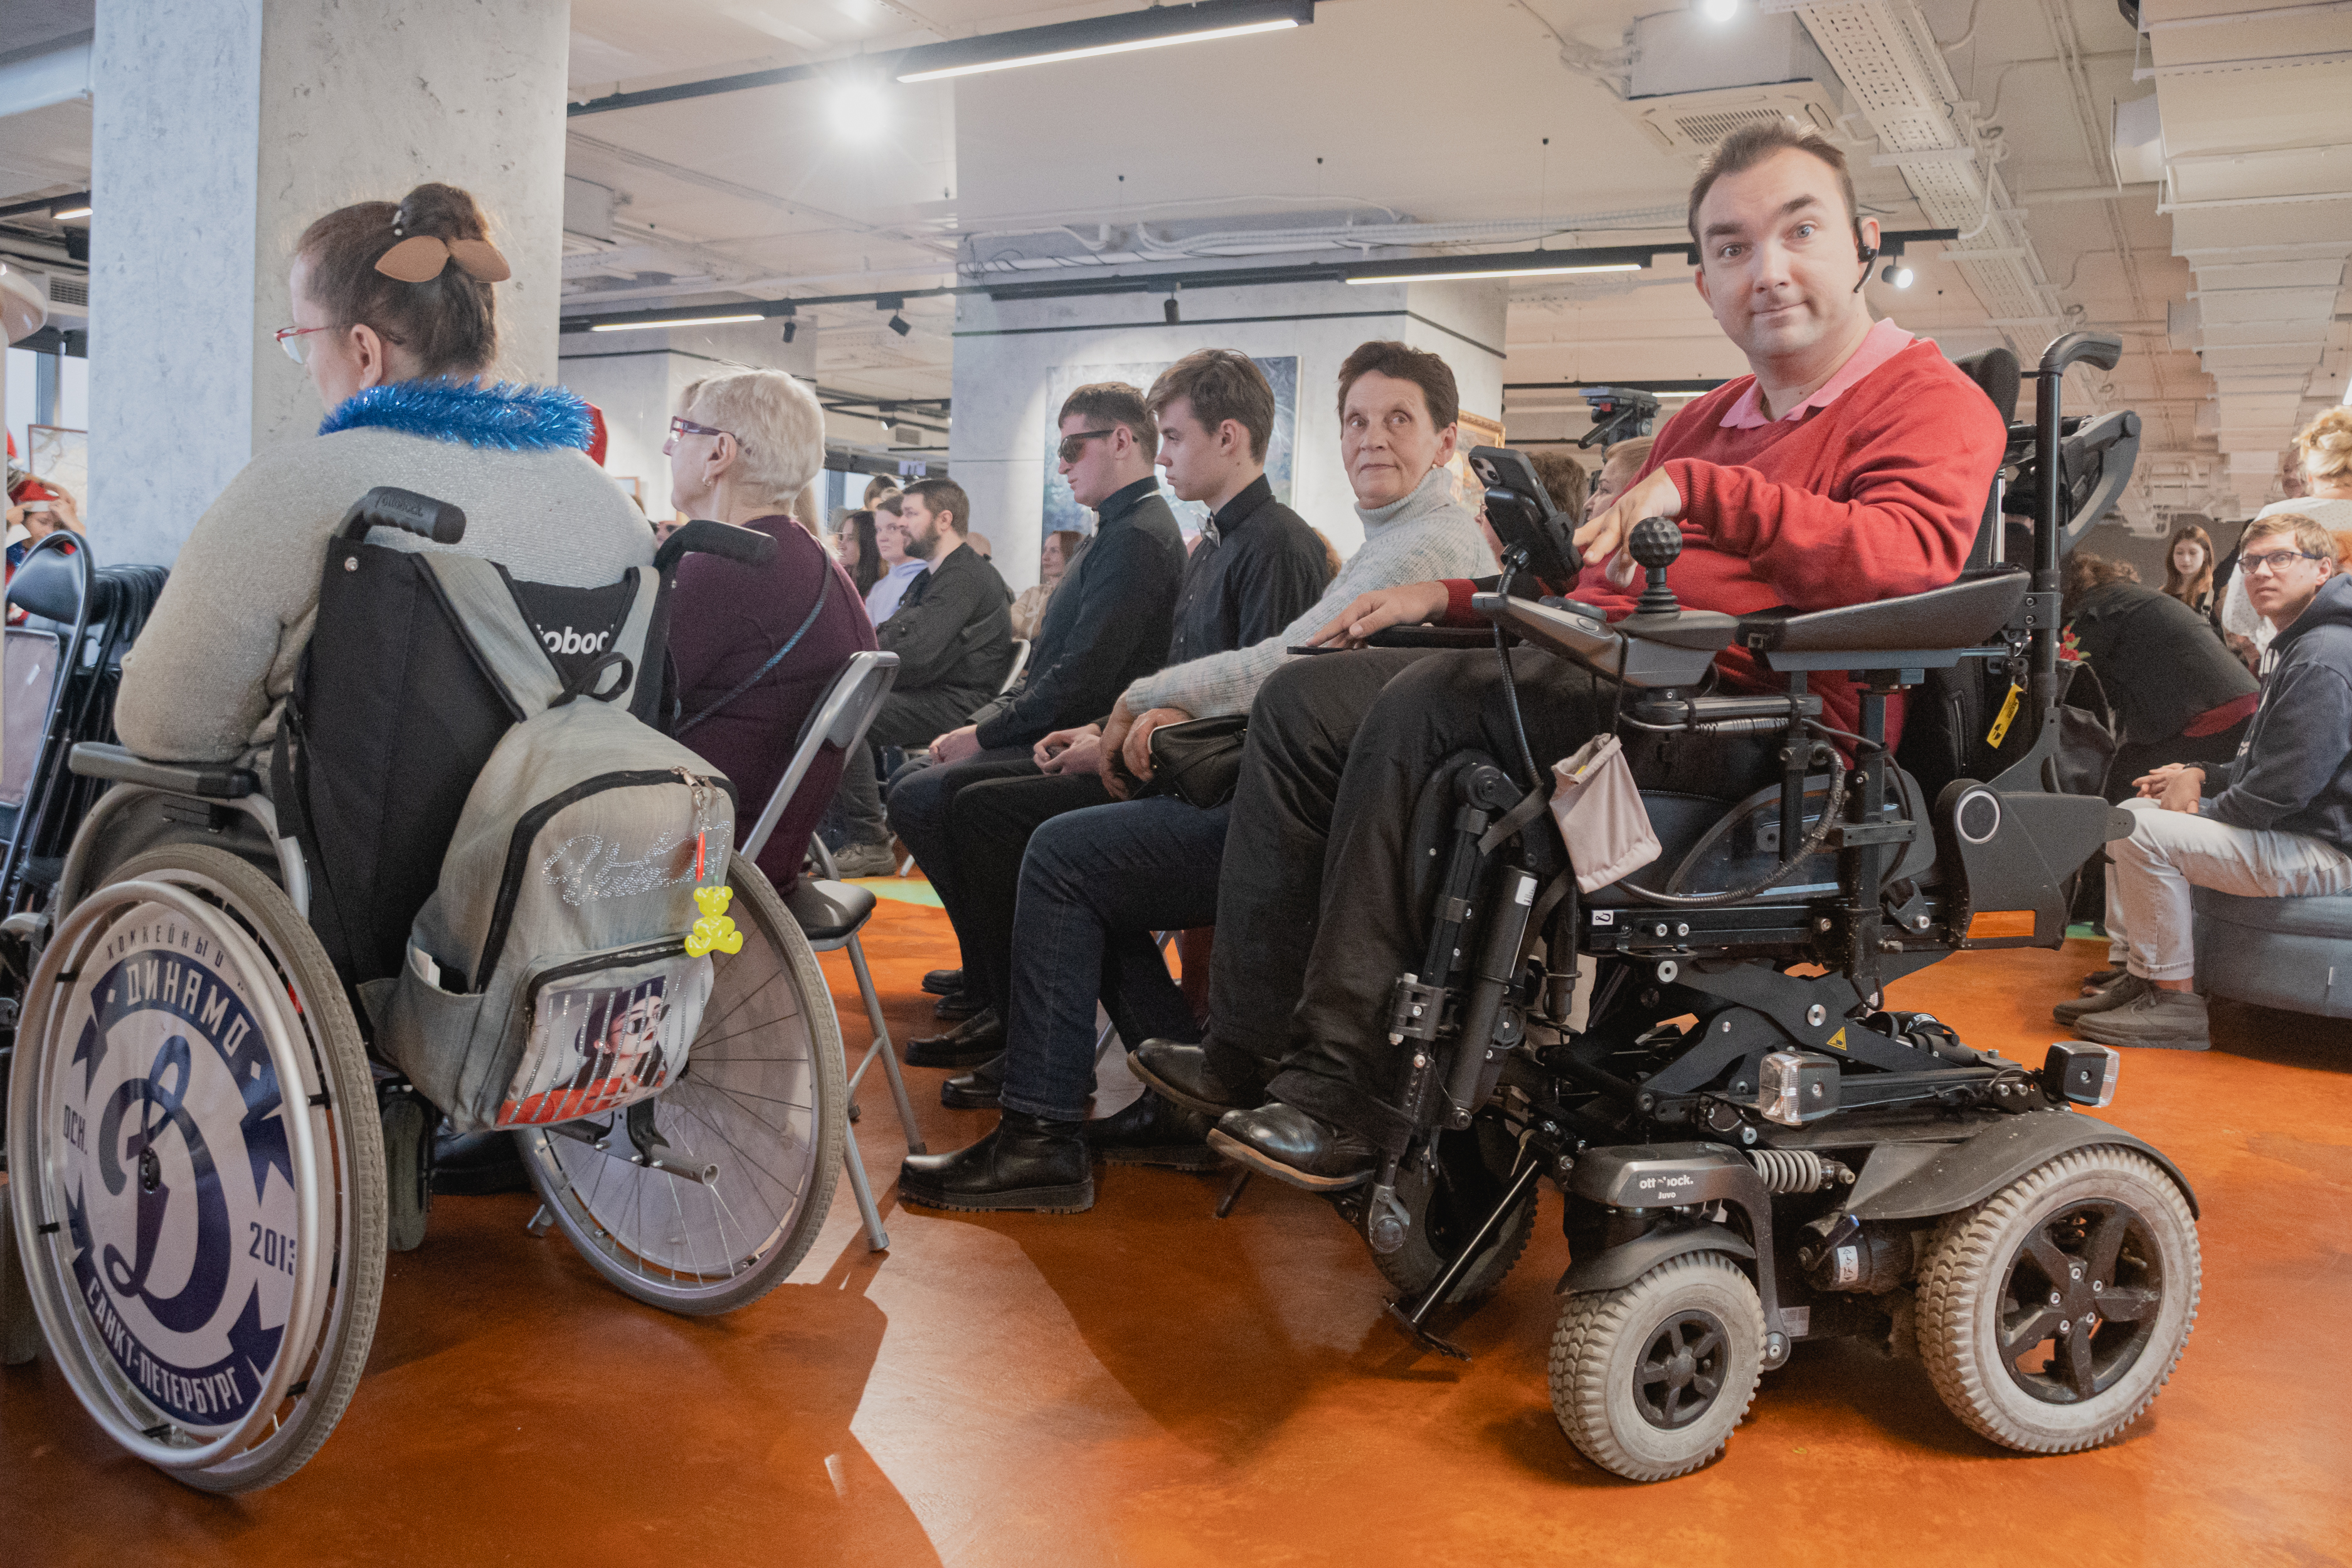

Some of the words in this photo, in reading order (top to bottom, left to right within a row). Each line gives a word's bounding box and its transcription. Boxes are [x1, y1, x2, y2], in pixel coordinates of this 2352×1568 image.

[126, 959, 251, 1057] ДИНАМО
[63, 1104, 88, 1155] ОСН.
[86, 1276, 243, 1414] САНКТ-ПЕТЕРБУРГ
